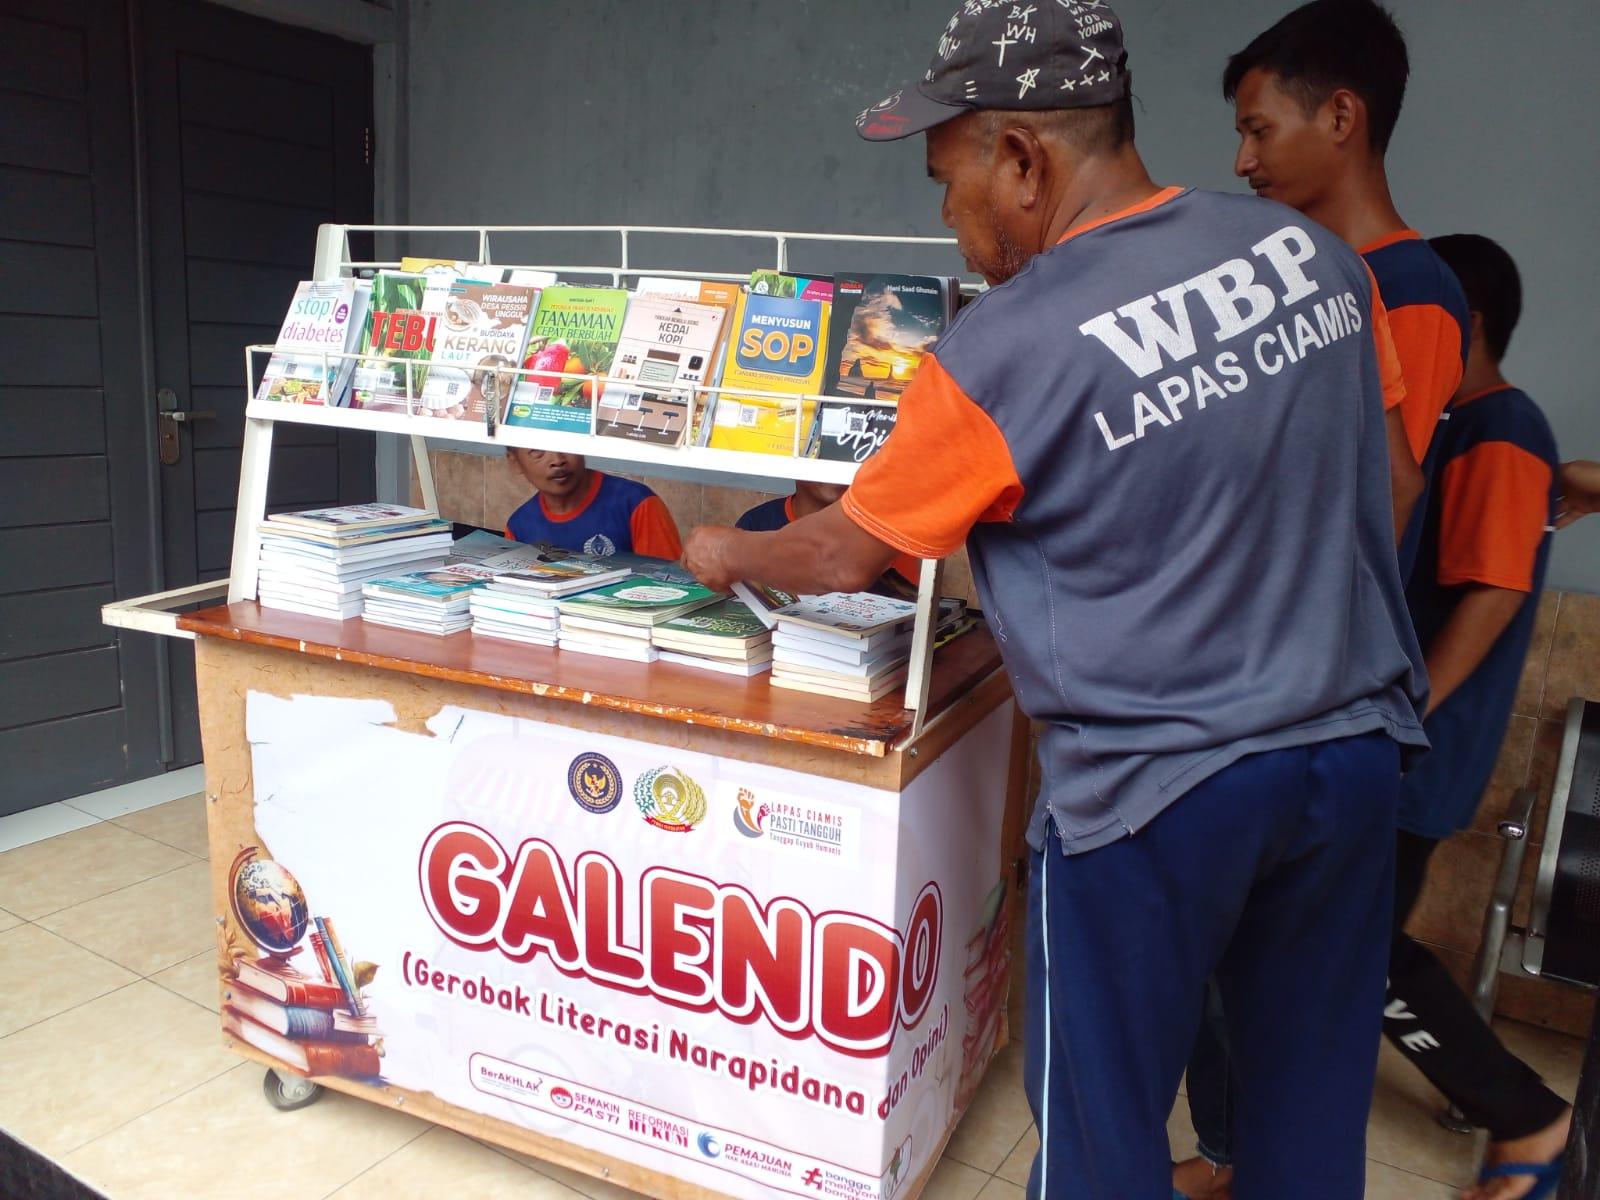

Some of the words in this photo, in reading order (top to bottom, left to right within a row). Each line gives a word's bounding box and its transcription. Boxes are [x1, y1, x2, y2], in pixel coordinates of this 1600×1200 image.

[482, 294, 528, 304] WIRAUSAHA
[1078, 226, 1317, 378] WBP
[495, 310, 523, 319] UNGGUL
[540, 310, 616, 330] TANAMAN
[751, 314, 812, 330] MENYUSUN
[282, 321, 345, 343] diabetes
[480, 329, 514, 338] BUDIDAYA
[536, 326, 566, 340] CEPAT
[566, 328, 613, 341] BERBUAH
[658, 321, 690, 335] KEDAI
[658, 333, 684, 345] KOPI
[441, 351, 471, 361] LAUT
[444, 336, 516, 354] KERANG
[740, 328, 814, 364] SOP
[1094, 351, 1249, 451] LAPAS
[1254, 292, 1362, 376] CIAMIS
[771, 802, 801, 818] LAPAS
[806, 810, 842, 827] CIAMIS
[770, 814, 796, 832] PASTI
[798, 820, 841, 842] TANGGUH
[418, 820, 943, 1059] GALENDO
[402, 951, 531, 1017] (Gerobak
[540, 993, 660, 1053] Literasi
[669, 1028, 866, 1116] Narapidana
[877, 1073, 909, 1121] dan
[911, 1003, 949, 1080] Opini)
[480, 1066, 541, 1092] BerAKHLAK
[574, 1091, 620, 1114] SEMAKIN
[574, 1103, 620, 1125] PASTI
[628, 1109, 689, 1136] REFORMASI
[629, 1119, 689, 1148] HUKUM
[724, 1143, 792, 1171] PEMAJUAN
[825, 1170, 871, 1191] bangga
